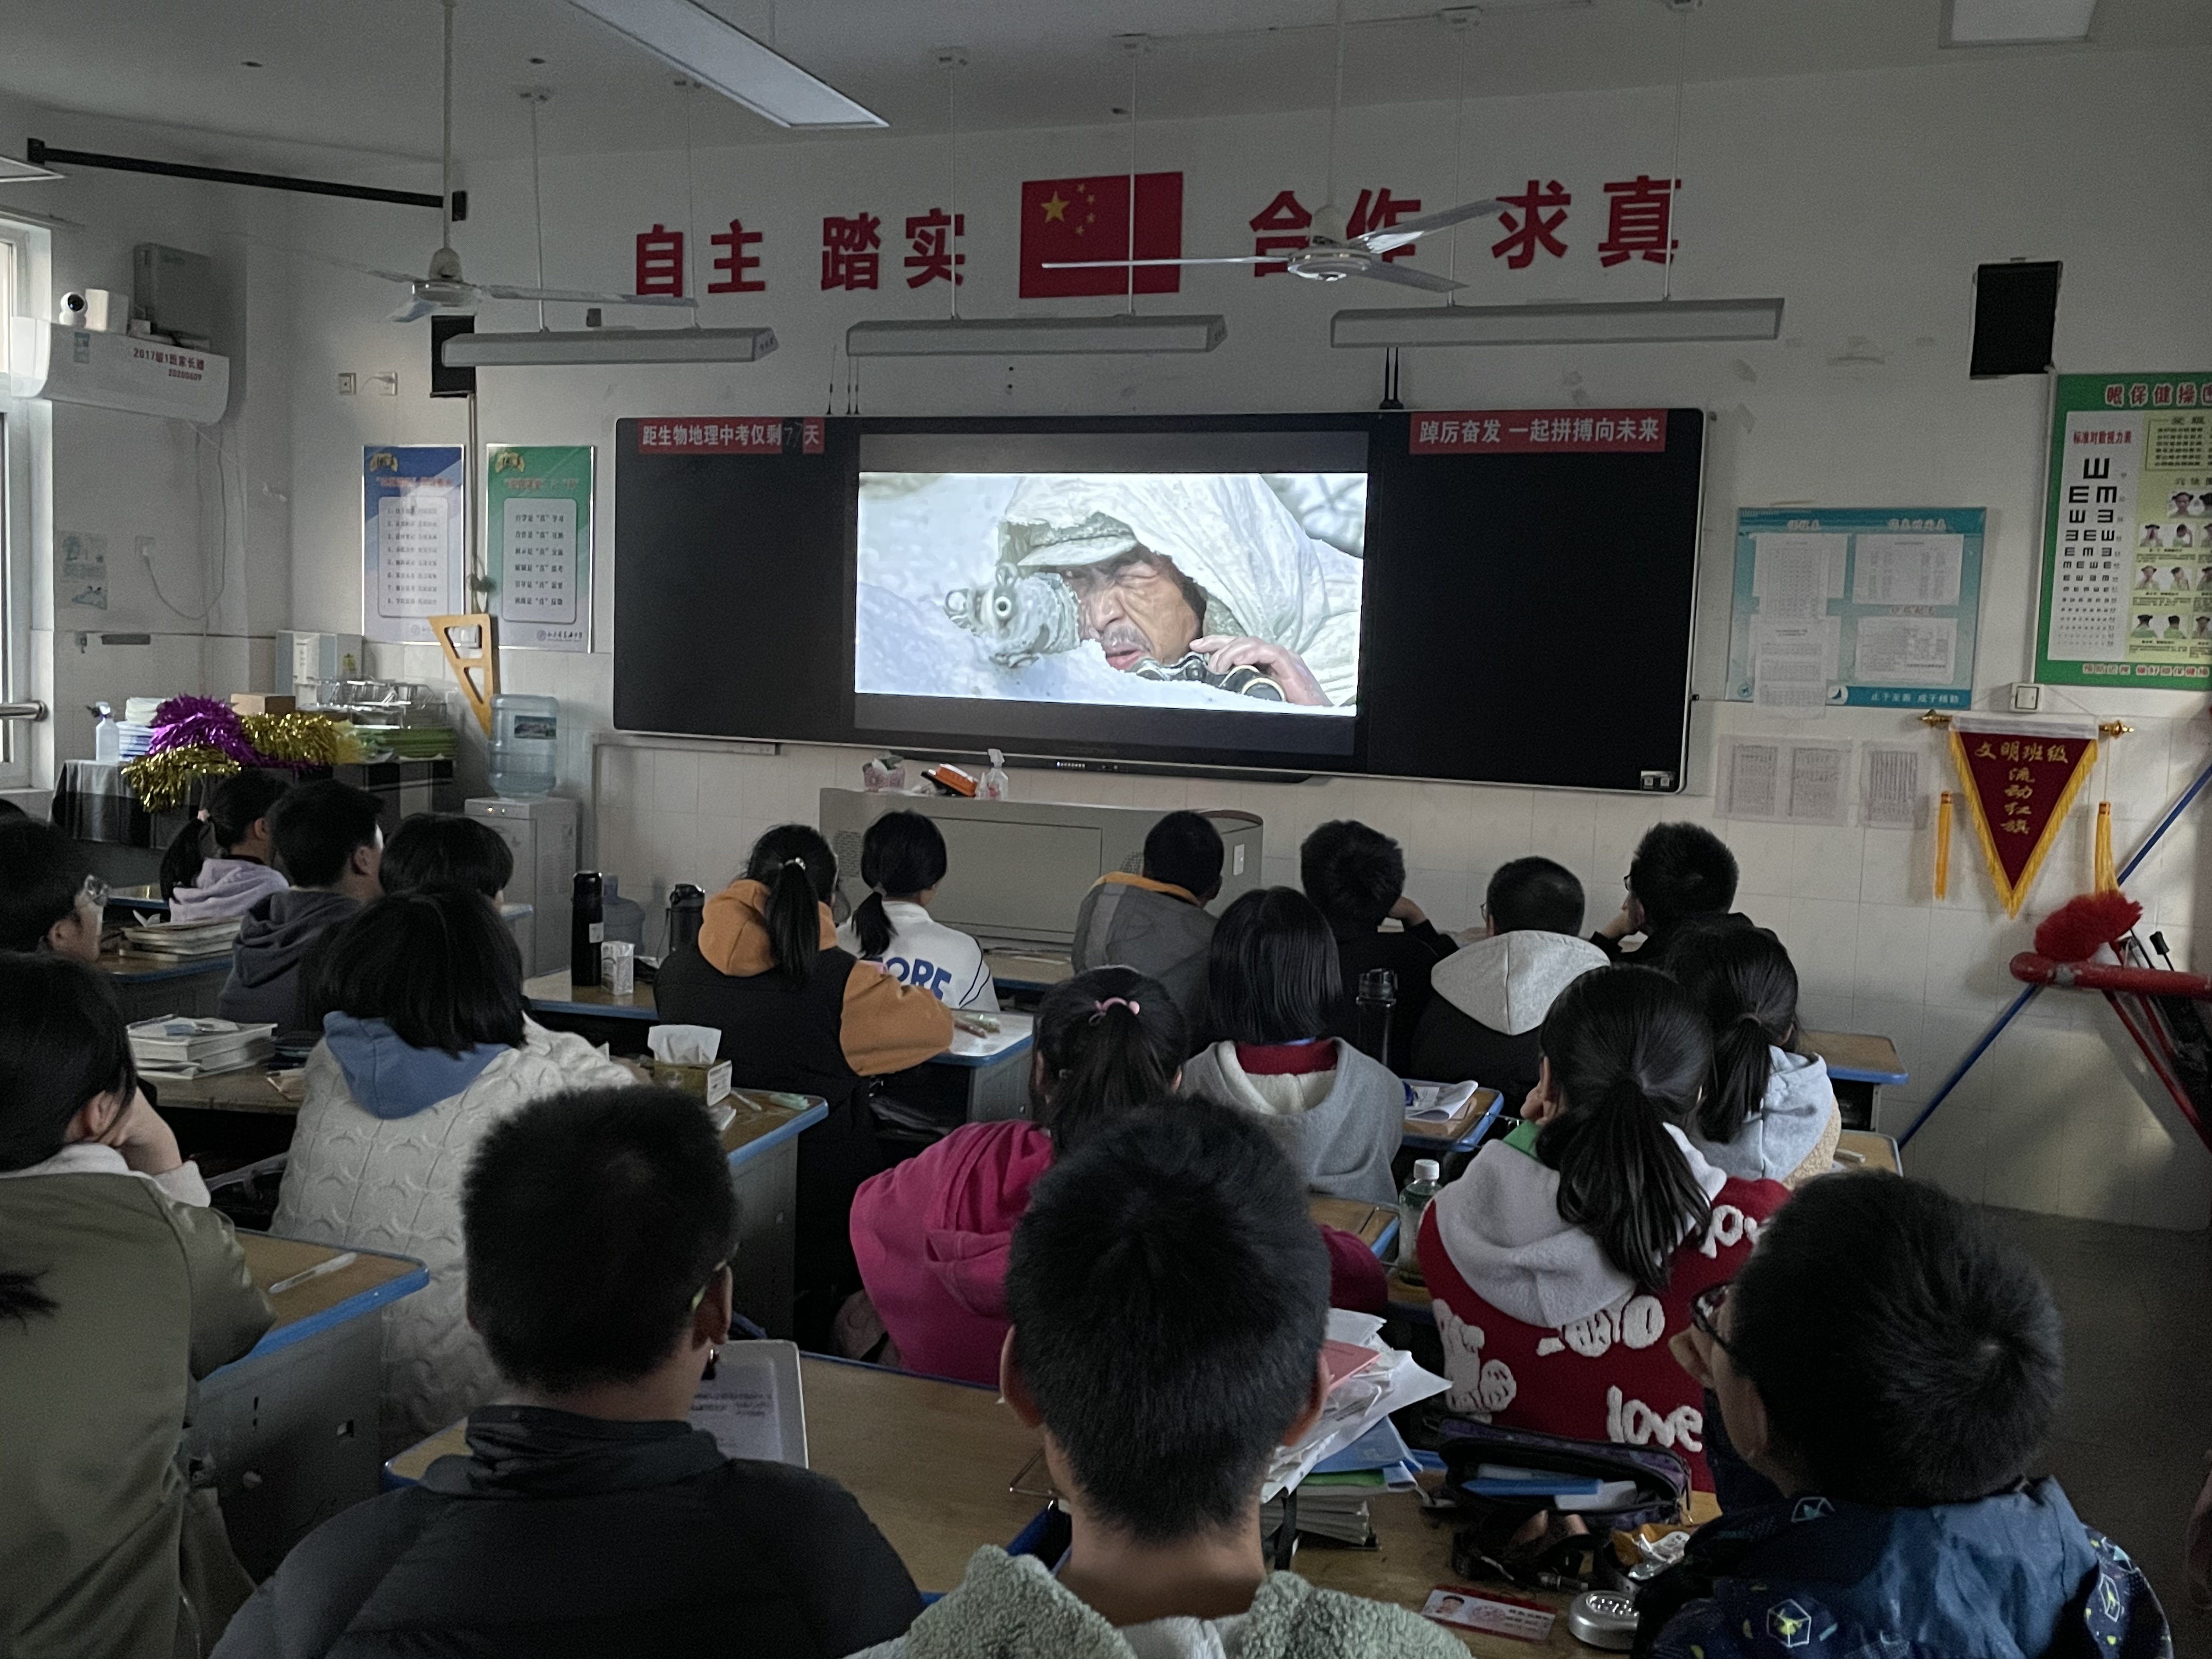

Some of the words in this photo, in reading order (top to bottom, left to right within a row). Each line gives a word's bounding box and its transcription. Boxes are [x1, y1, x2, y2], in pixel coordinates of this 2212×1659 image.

[636, 219, 766, 297] 自主
[820, 208, 965, 291] 踏实
[1492, 175, 1681, 269] 求真
[642, 424, 782, 445] 距生物地理中考仅剩
[804, 425, 820, 445] 天
[1419, 420, 1501, 444] 踔厉奋发
[1509, 417, 1660, 443] 一起拼搏向未来
[2073, 430, 2132, 445] 标准对数视力表
[1976, 741, 2068, 763] 文明班级
[2000, 767, 2035, 834] 流动红旗
[1606, 1385, 1703, 1452] love
